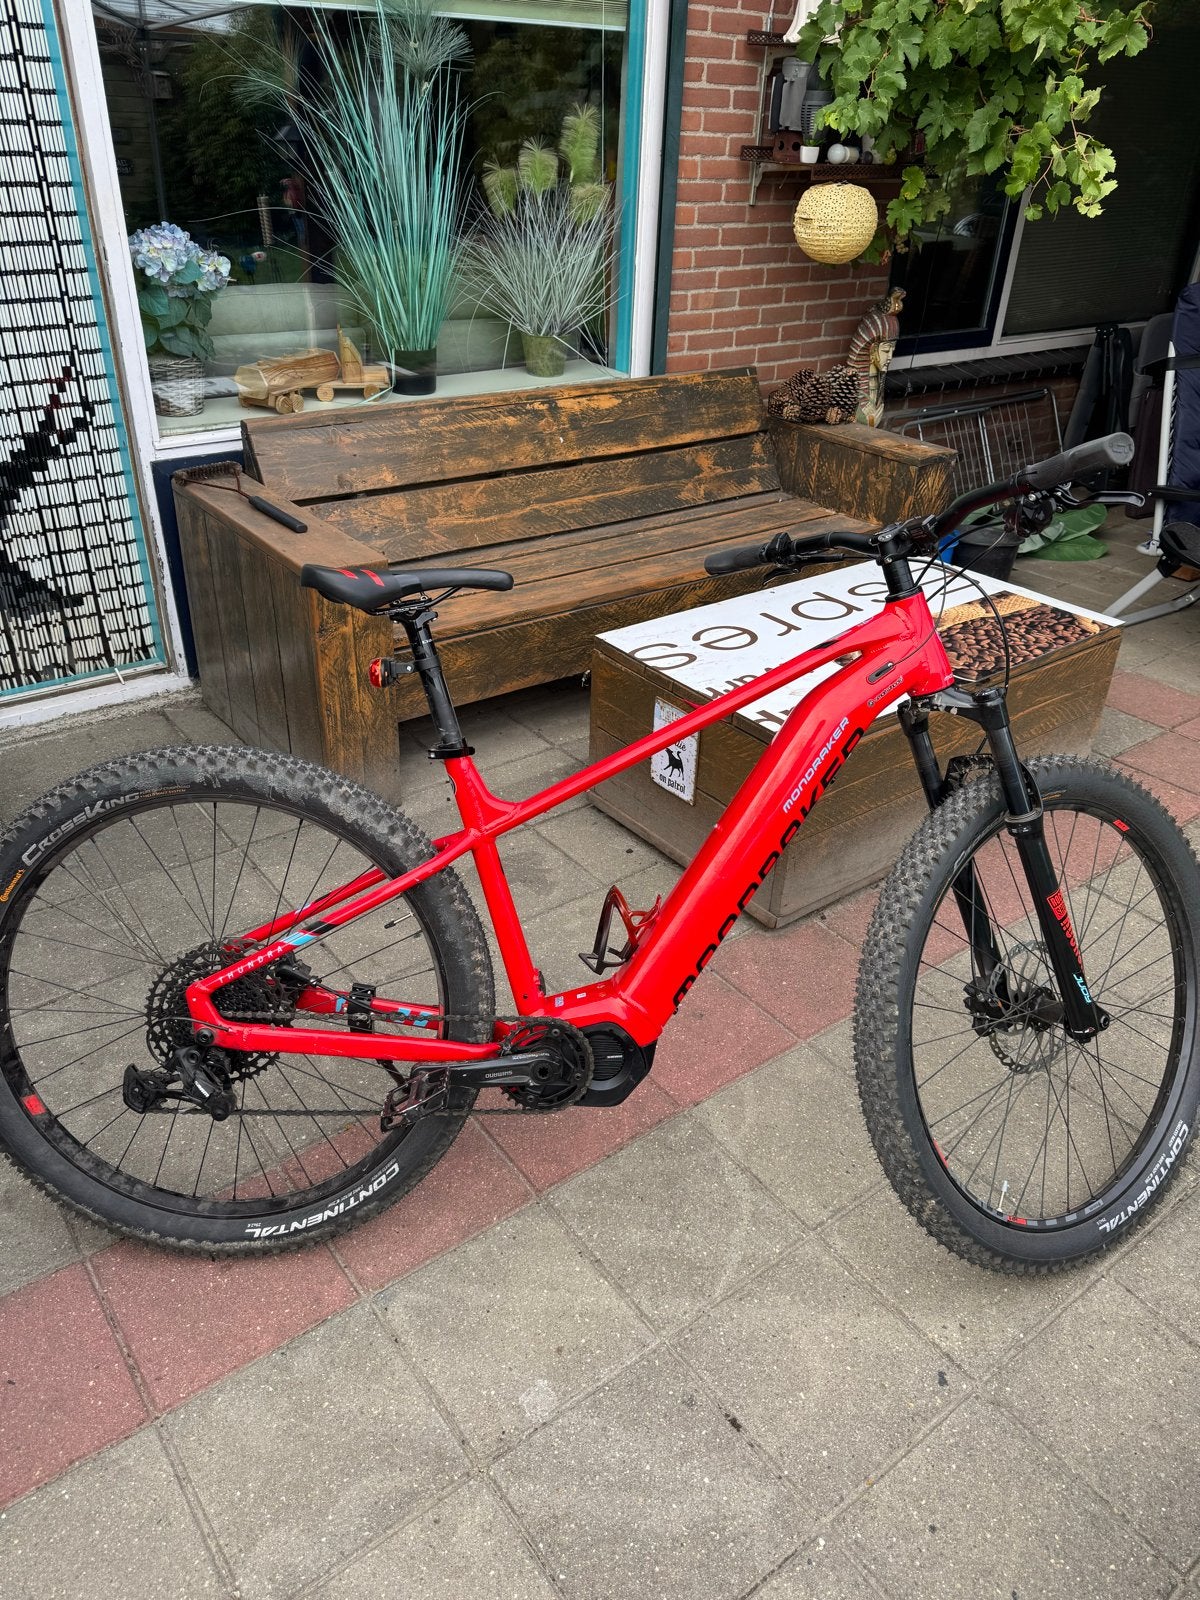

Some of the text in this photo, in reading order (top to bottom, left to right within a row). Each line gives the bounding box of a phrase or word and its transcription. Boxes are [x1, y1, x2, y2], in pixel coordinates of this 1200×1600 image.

[659, 774, 686, 794] on patrol
[783, 717, 849, 813] MONDRAKER
[219, 945, 283, 983] THUNDRA
[1073, 972, 1092, 1005] JUDY
[485, 1070, 513, 1079] SHIMANO
[1098, 1123, 1189, 1233] CONTINENTAL
[245, 1162, 400, 1238] CONTINENTAL
